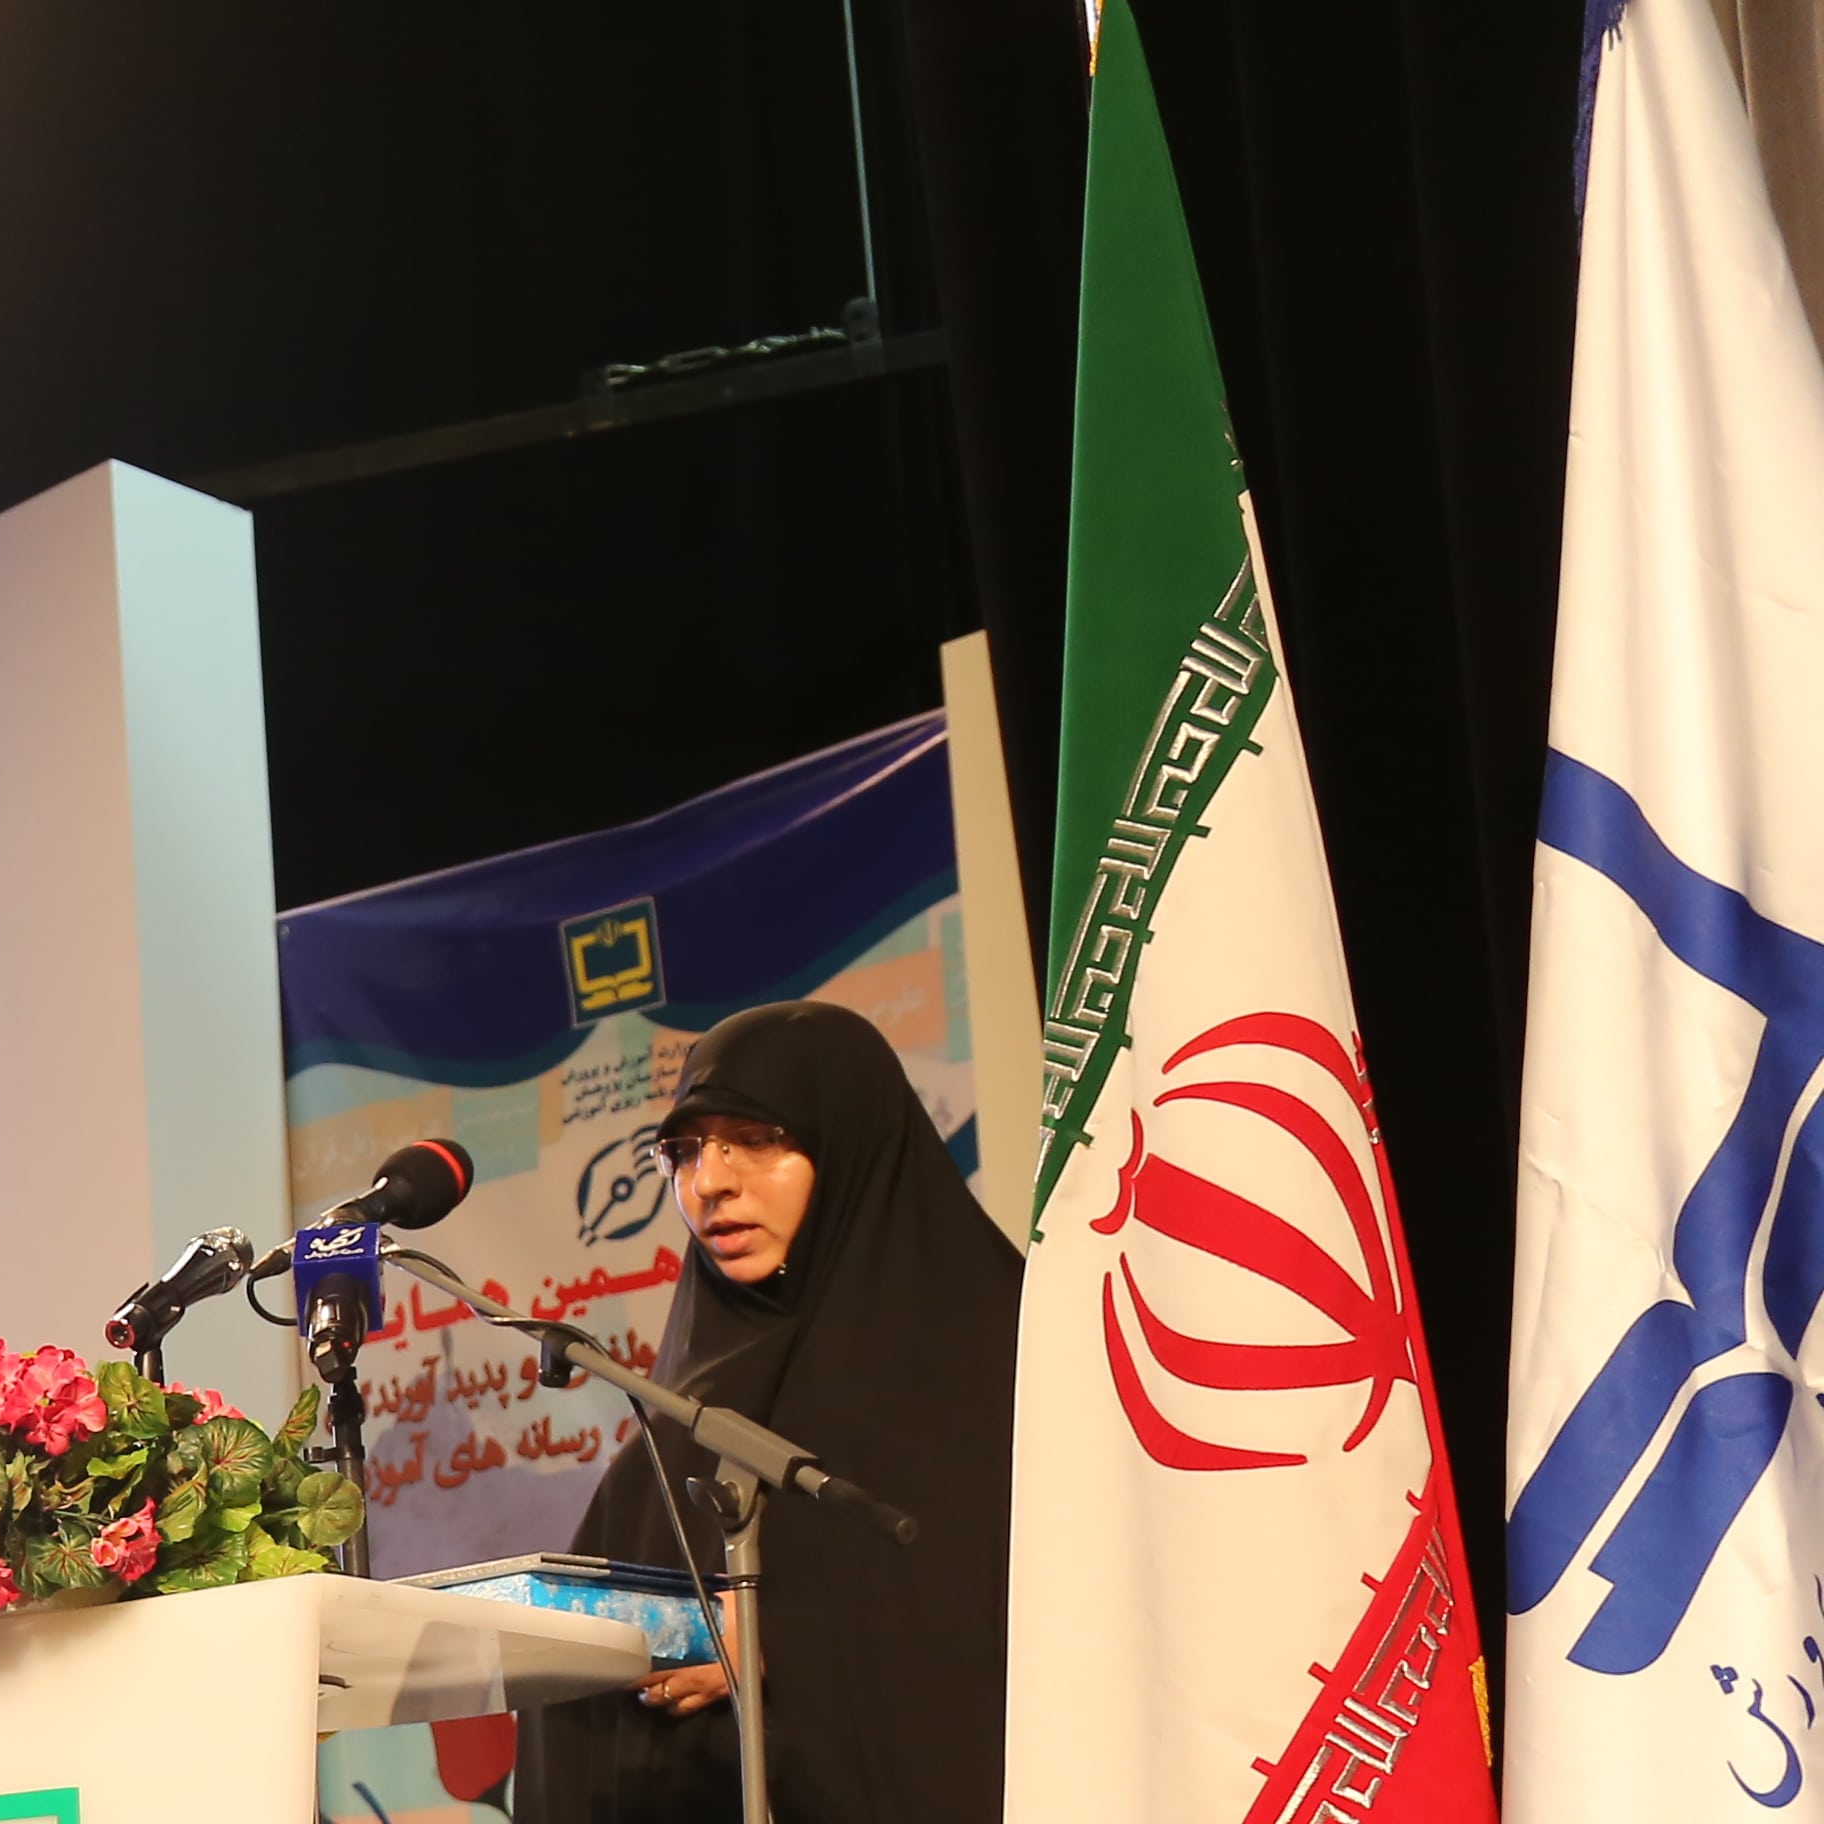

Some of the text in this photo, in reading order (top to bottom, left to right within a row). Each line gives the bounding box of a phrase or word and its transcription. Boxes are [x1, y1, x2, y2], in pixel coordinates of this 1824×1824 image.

[448, 1358, 509, 1409] پدید
[516, 1356, 539, 1401] و
[434, 1432, 507, 1489] های
[516, 1416, 600, 1462] رسانه
[364, 1432, 431, 1508] آموز
